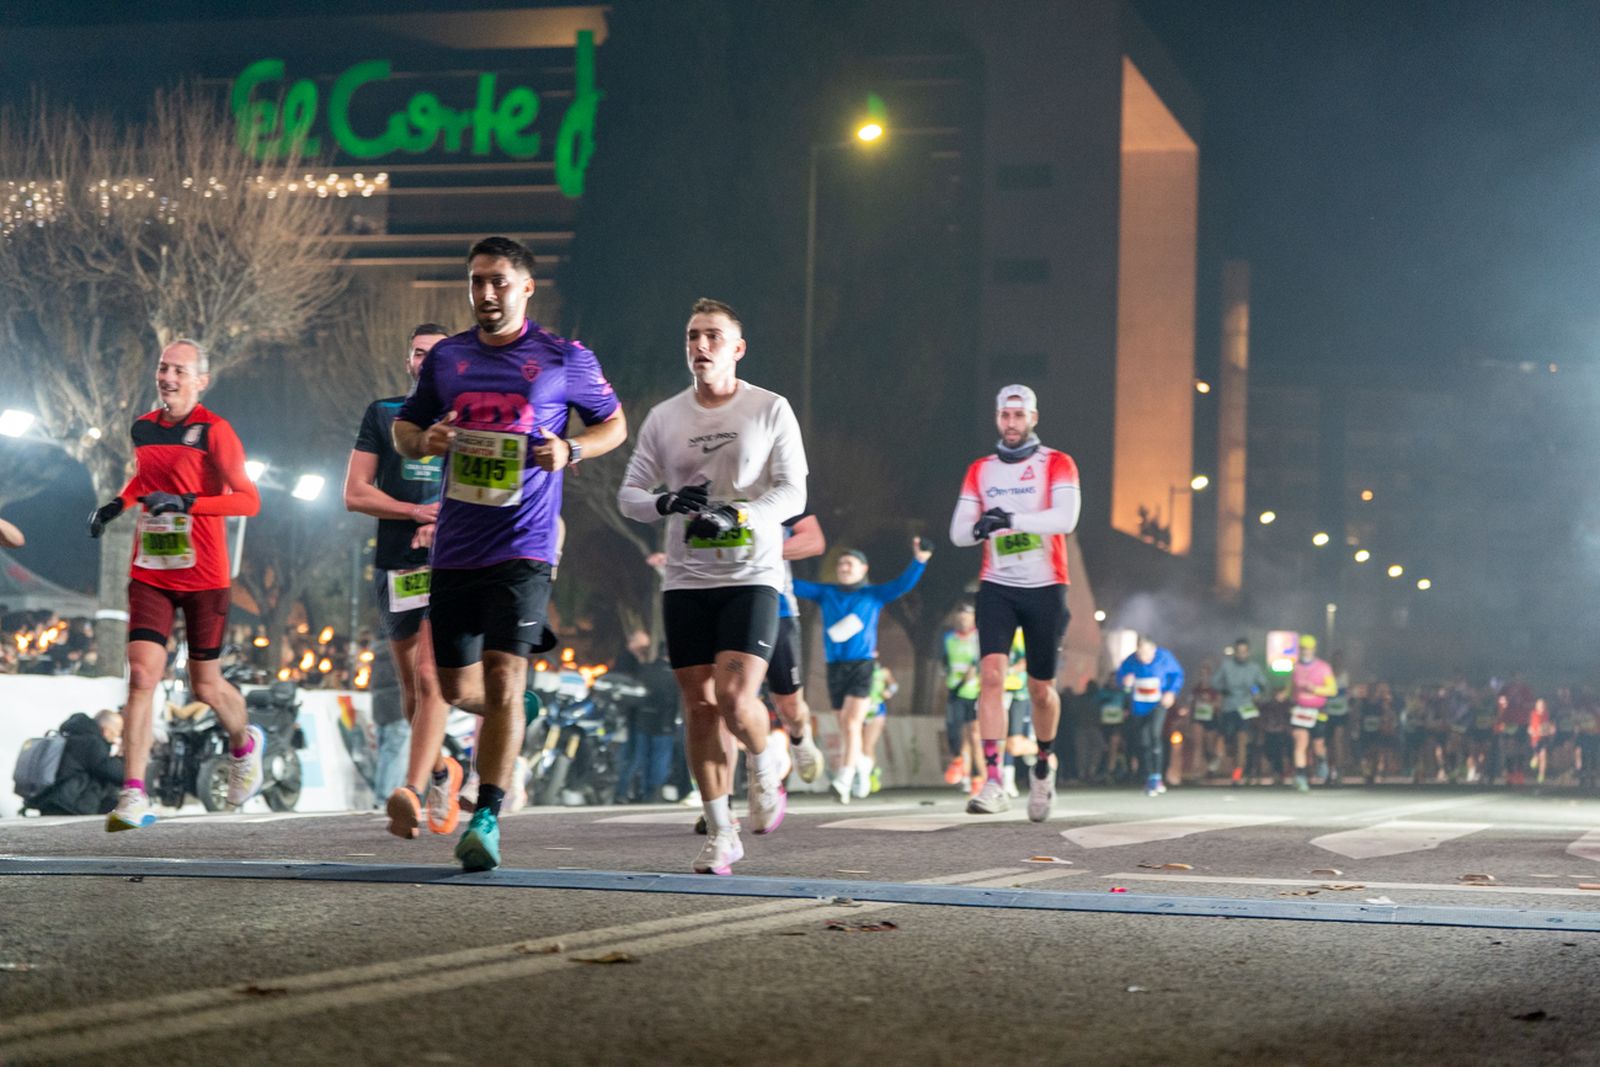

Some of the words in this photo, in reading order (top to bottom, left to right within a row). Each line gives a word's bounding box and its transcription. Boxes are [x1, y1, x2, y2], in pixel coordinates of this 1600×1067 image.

[231, 58, 321, 158] El
[327, 60, 541, 158] Corte
[462, 454, 507, 481] 2415
